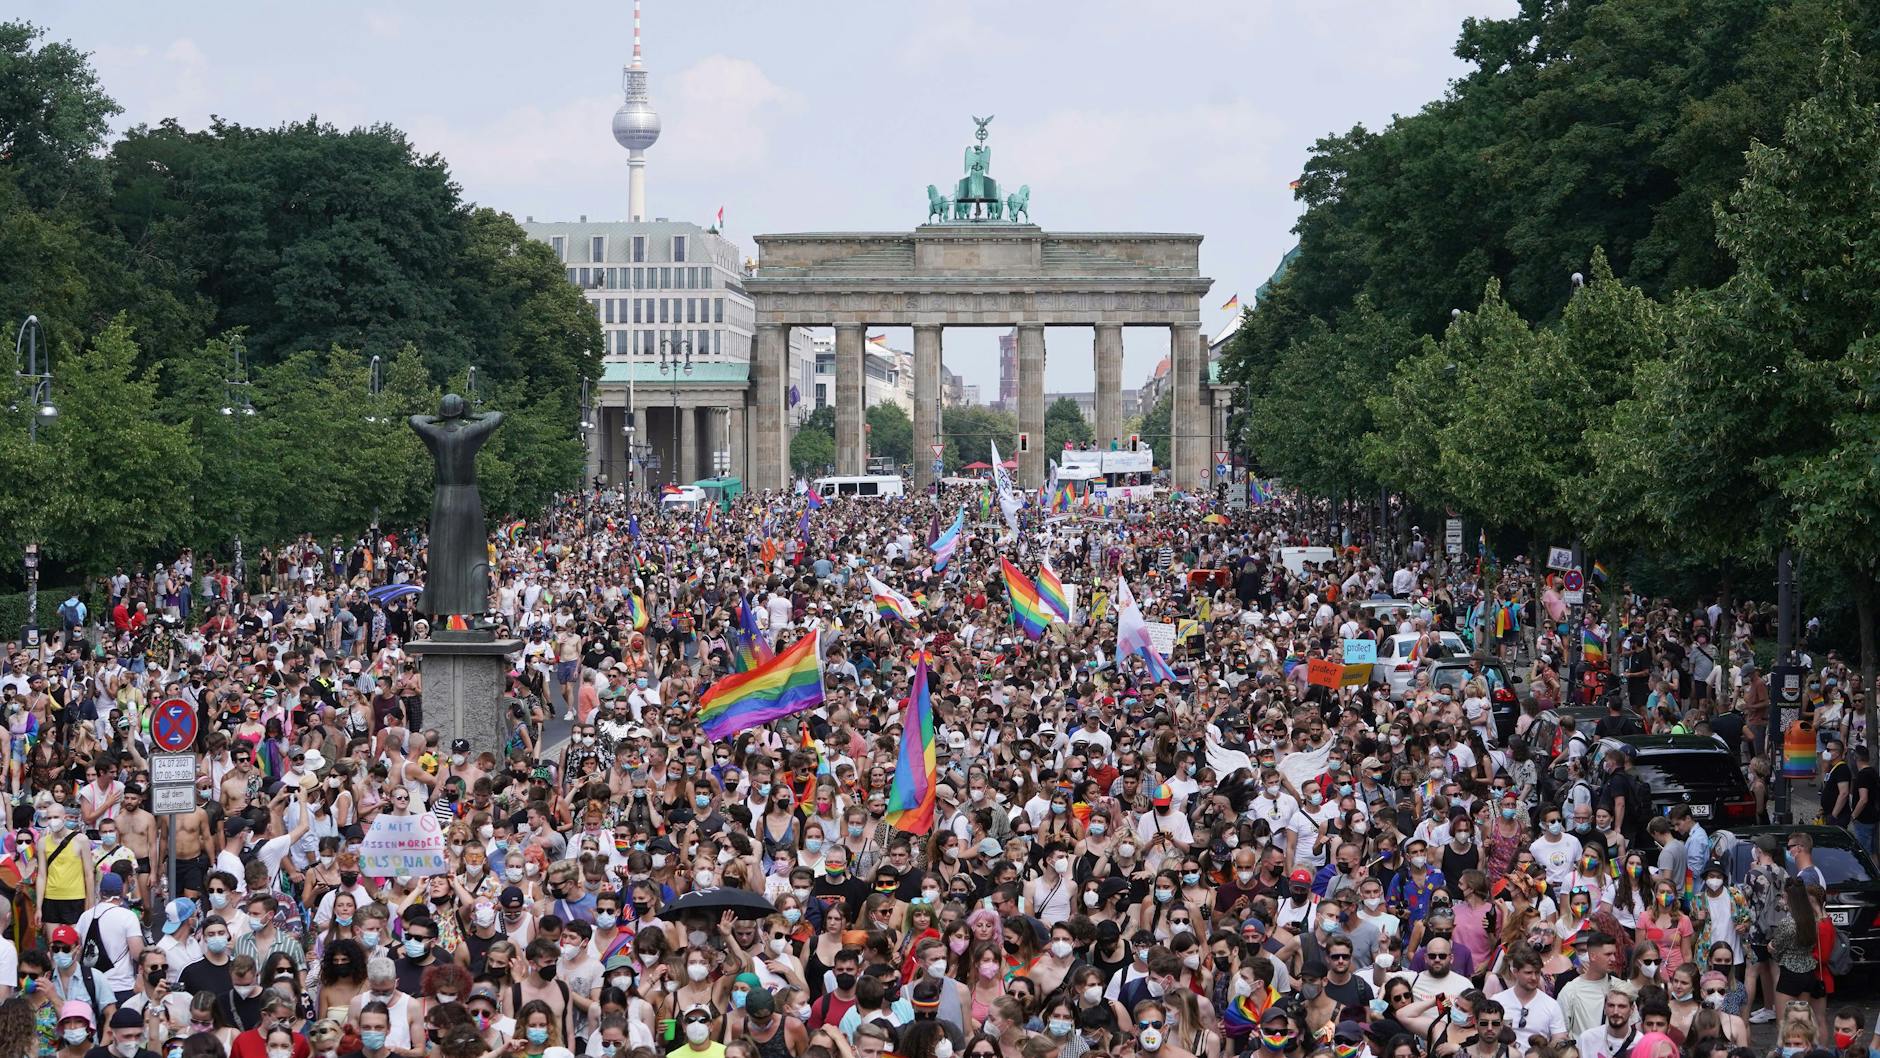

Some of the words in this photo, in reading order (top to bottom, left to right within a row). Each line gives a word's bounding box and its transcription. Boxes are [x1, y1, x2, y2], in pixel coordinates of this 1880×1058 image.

[1346, 643, 1371, 655] protect
[1311, 664, 1338, 676] protect
[161, 790, 171, 799] auf
[172, 789, 184, 799] dem
[157, 799, 192, 810] Mittelstreifen
[1696, 805, 1706, 814] 52
[388, 822, 414, 832] MIT
[359, 853, 443, 870] BOLSONARO
[1832, 913, 1845, 923] 25
